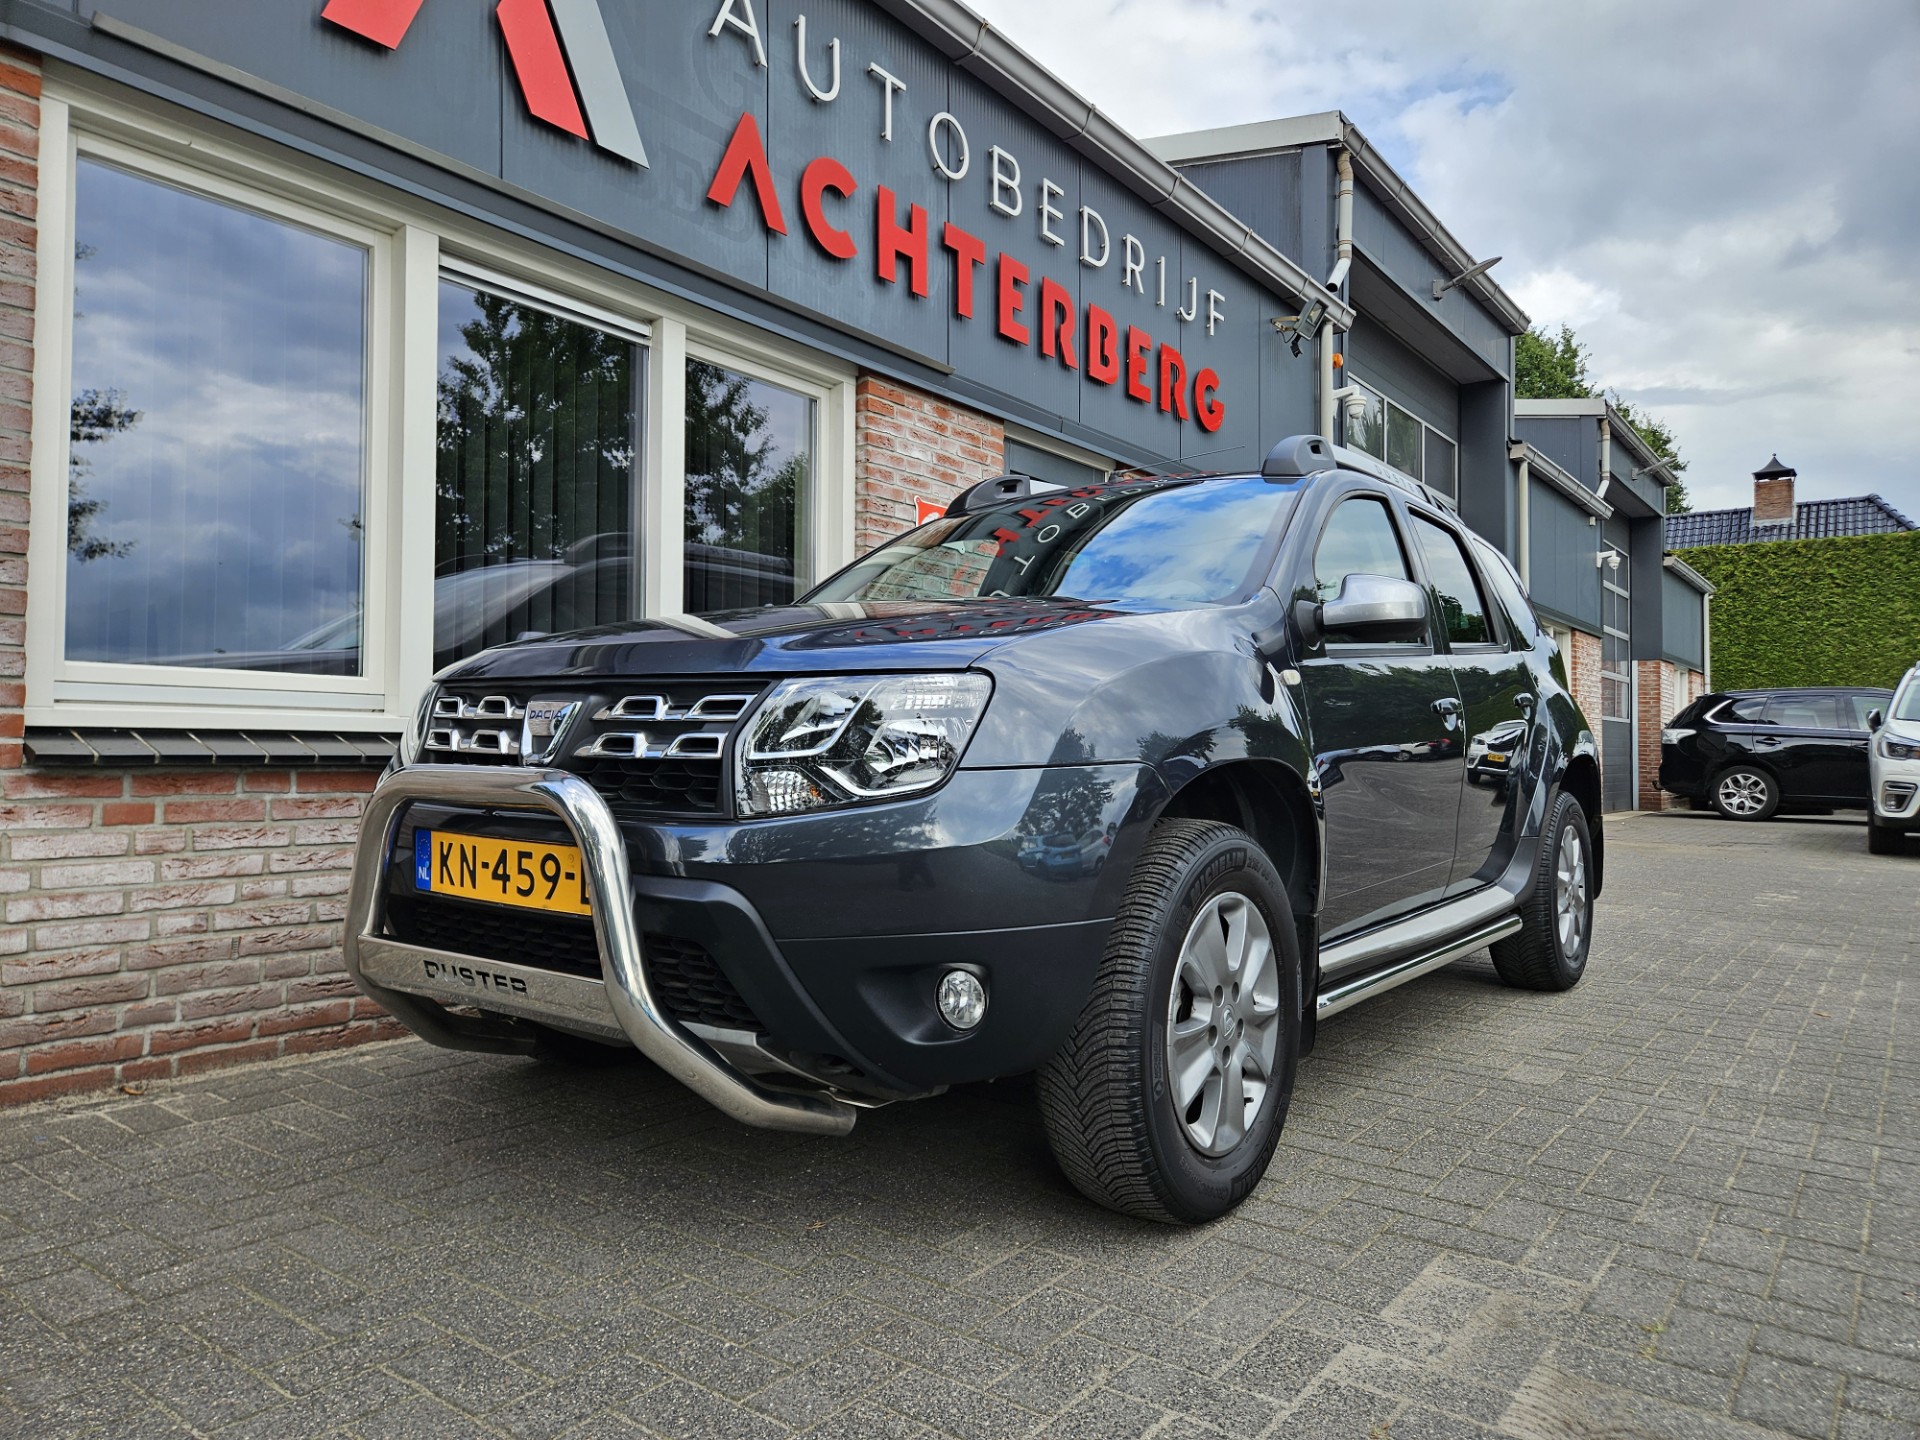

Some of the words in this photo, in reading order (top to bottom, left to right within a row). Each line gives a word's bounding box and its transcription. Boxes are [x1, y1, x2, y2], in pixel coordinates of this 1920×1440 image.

[708, 0, 1226, 336] AUTOBEDRIJF
[707, 112, 1225, 432] ACHTERBERG
[528, 709, 563, 719] DACIA
[418, 867, 430, 880] NL
[1190, 850, 1246, 907] MICHELIN
[423, 960, 529, 999] DUSTER
